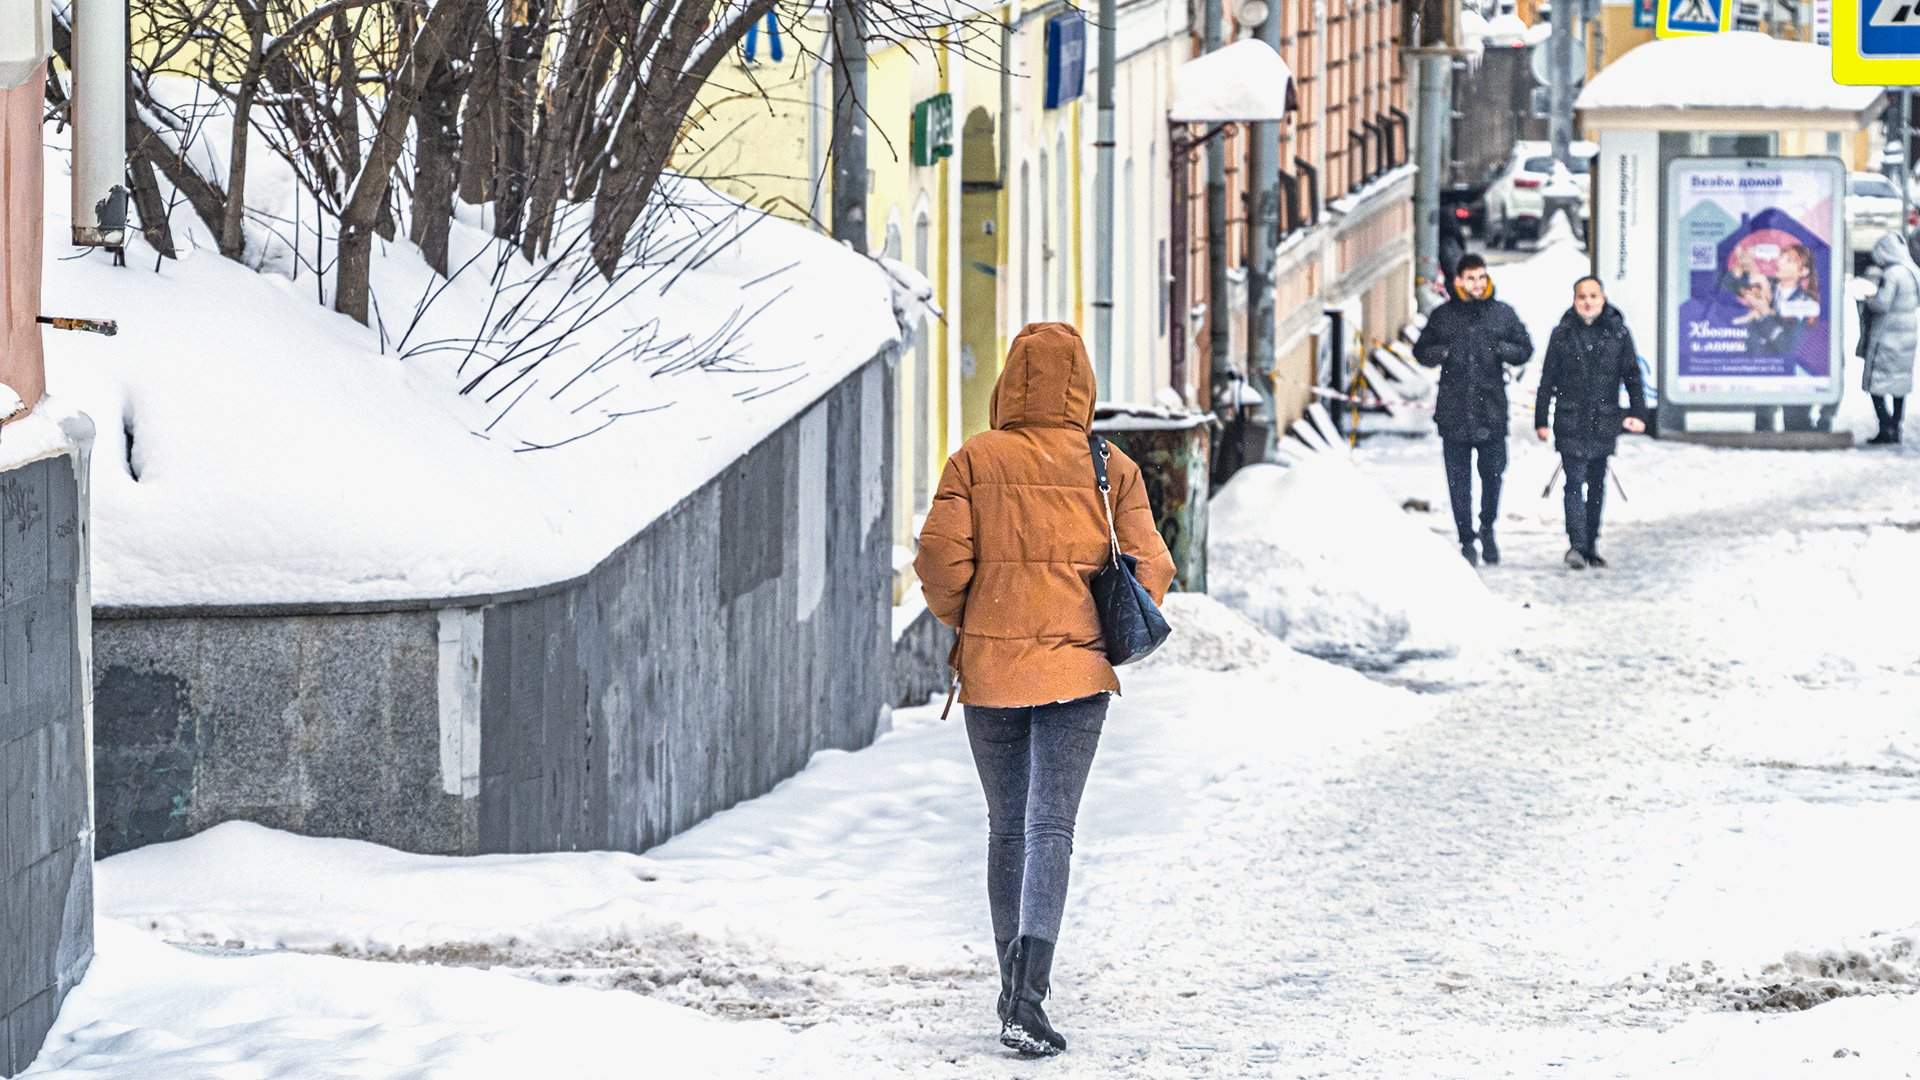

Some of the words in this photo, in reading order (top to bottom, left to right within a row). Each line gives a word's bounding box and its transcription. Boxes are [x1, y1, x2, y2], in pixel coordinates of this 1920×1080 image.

[1691, 174, 1735, 187] Везём
[1739, 175, 1783, 188] домой
[1688, 320, 1748, 338] Хвосты
[1691, 341, 1701, 352] и
